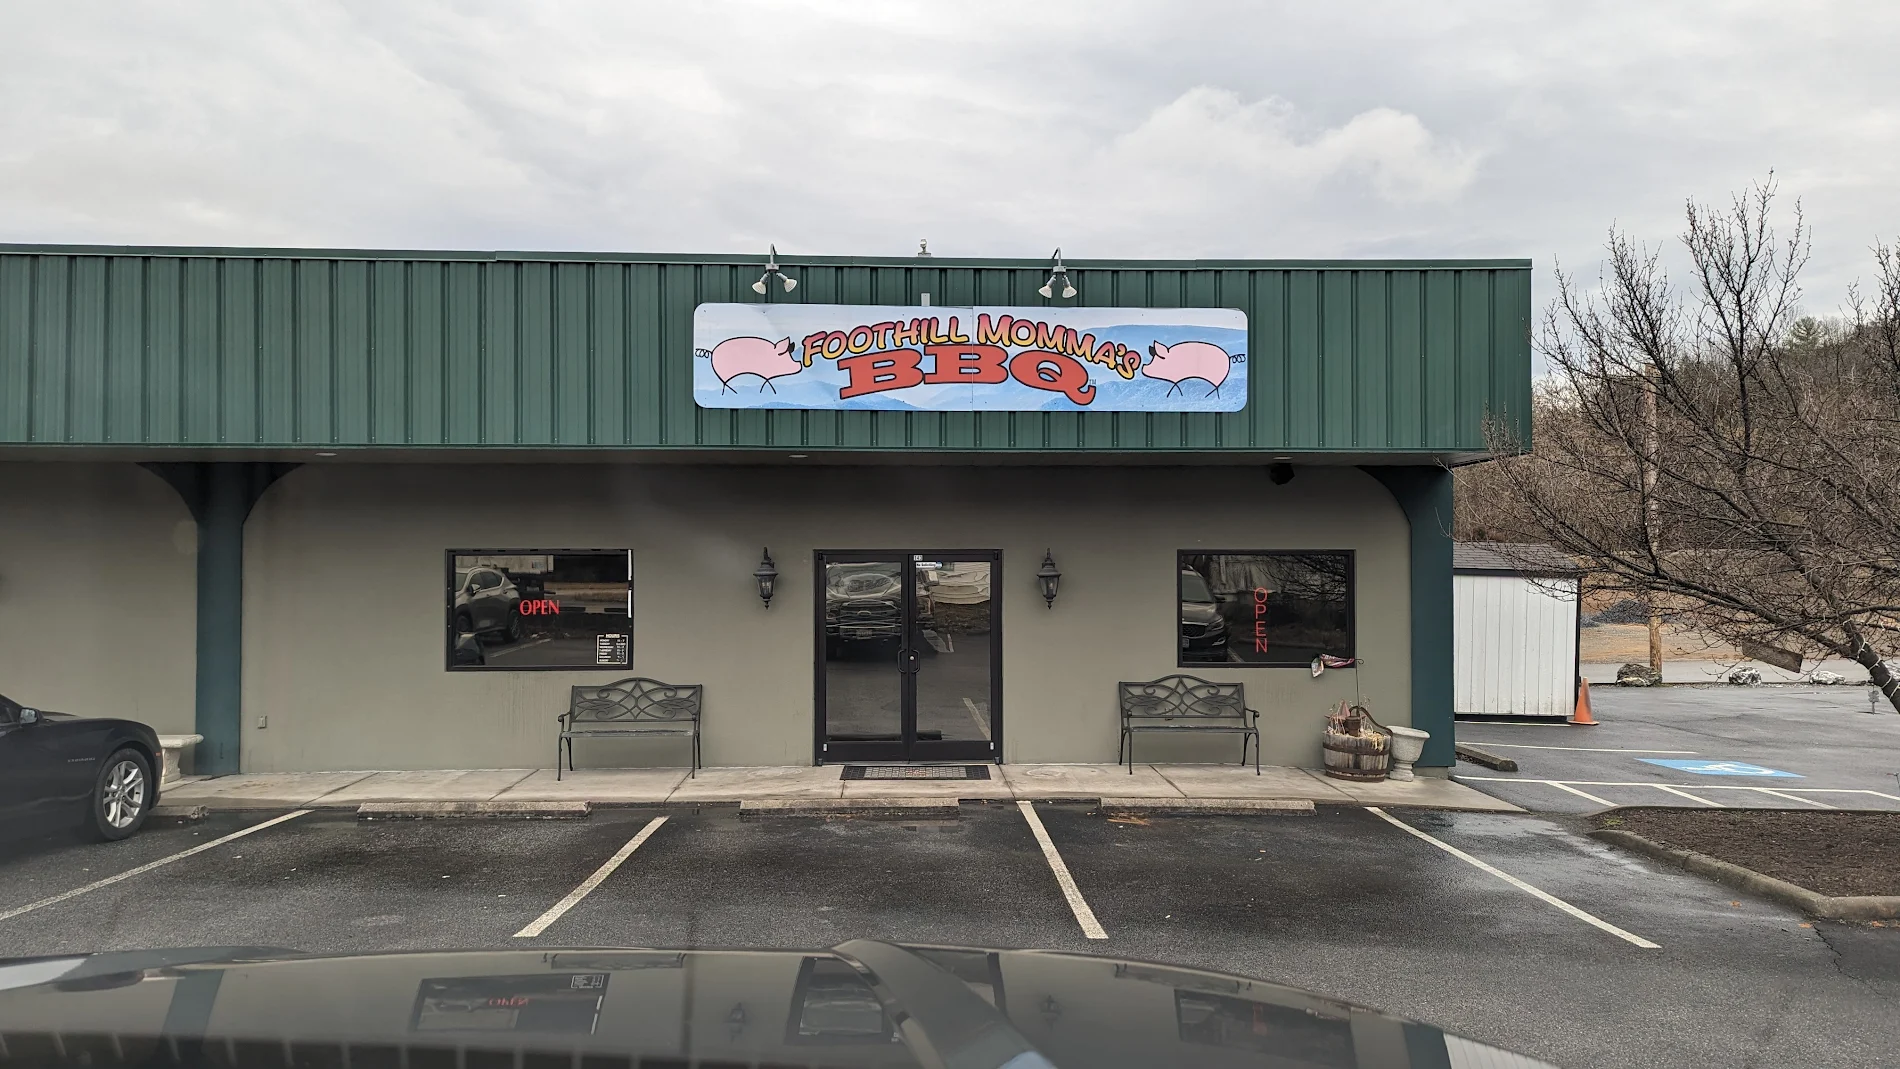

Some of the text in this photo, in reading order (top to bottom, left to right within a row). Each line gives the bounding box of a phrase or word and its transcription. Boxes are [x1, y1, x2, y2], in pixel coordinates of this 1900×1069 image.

[802, 313, 1142, 380] FOOTHILL MOMMA'S
[837, 344, 1096, 406] BBQ
[520, 599, 560, 615] OPEN
[1254, 587, 1268, 653] OPEN
